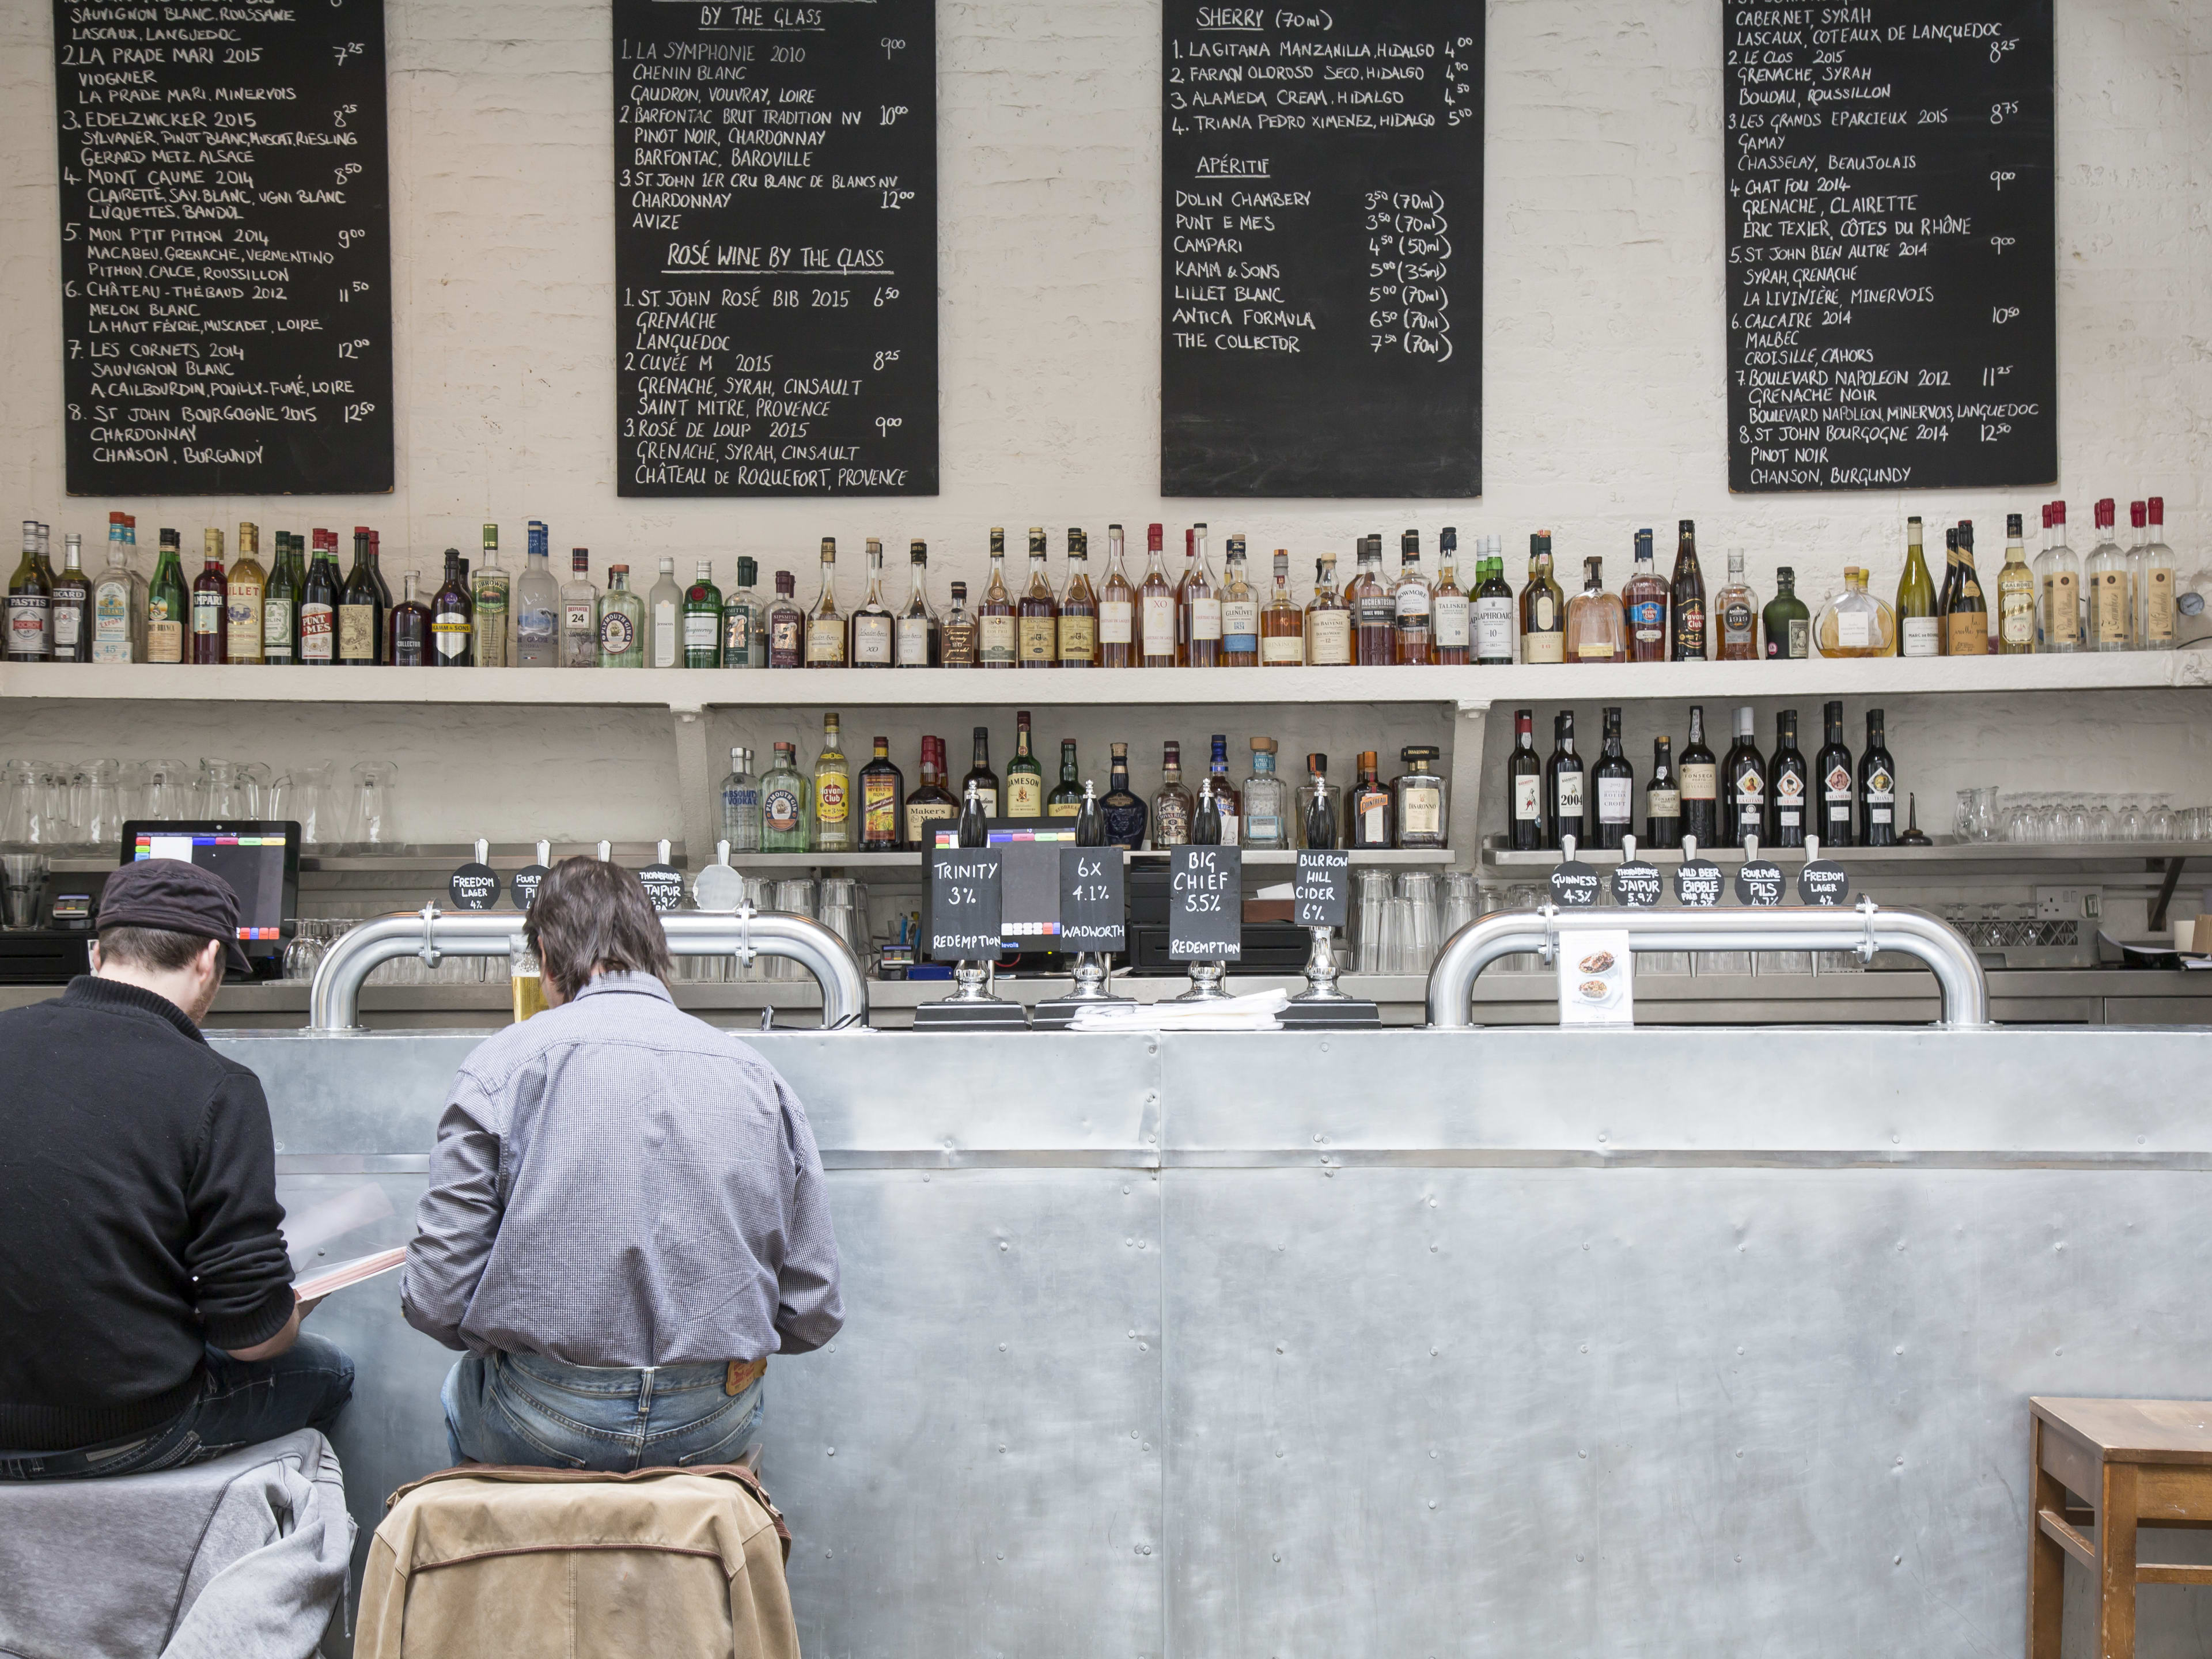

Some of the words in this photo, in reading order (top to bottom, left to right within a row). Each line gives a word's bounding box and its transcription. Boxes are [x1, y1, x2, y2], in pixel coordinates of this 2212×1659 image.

[702, 6, 721, 25] BY
[732, 6, 763, 25] THE
[775, 8, 821, 27] GLASS
[1196, 7, 1263, 27] SHERRY
[1276, 9, 1332, 30] (70ml)
[79, 47, 105, 65] LA
[113, 48, 165, 64] PRADE
[173, 48, 213, 63] MARI
[224, 48, 263, 63] 2015
[637, 42, 656, 59] LA
[664, 42, 755, 61] SYMPHONIE
[771, 46, 805, 62] 2010
[79, 70, 157, 86] VIOGNIER
[86, 112, 207, 127] EDELZWICKER
[214, 112, 256, 127] 2015
[635, 107, 712, 123] BARFONTAC
[724, 108, 756, 124] BRUT
[763, 110, 831, 124] TRADITION
[842, 112, 861, 124] NV
[1738, 133, 1785, 154] GAMAY
[1198, 154, 1268, 173] APÉRITIF
[89, 169, 136, 184] MONT
[148, 171, 204, 185] CAUME
[216, 171, 253, 188] 2014
[1745, 179, 1780, 195] CHAT
[1785, 179, 1808, 194] FOU
[1817, 176, 1850, 191] 2014
[632, 191, 731, 208] CHARDONNAY
[1176, 191, 1222, 207] DOLIN
[1232, 191, 1310, 207] CHAMBERY
[1176, 214, 1213, 230] PUNT
[1224, 216, 1233, 228] E
[1240, 215, 1274, 231] MES
[1174, 236, 1241, 253] CAMPARI
[668, 240, 710, 265] ROSÉ
[718, 246, 761, 267] WINE
[770, 247, 790, 267] BY
[801, 248, 830, 267] THE
[837, 248, 884, 275] GLASS
[1176, 260, 1221, 278] KAMM
[1228, 266, 1238, 278] &
[1241, 262, 1279, 279] SONS
[1176, 286, 1226, 301] LILLET
[1234, 287, 1285, 302] BLANC
[90, 304, 139, 316] MELON
[149, 304, 200, 316] BLANC
[637, 312, 717, 334] GRENACHE
[1745, 313, 1812, 328] CALCAIRE
[1822, 310, 1851, 325] 2014
[637, 332, 729, 353] LANGUEDOC
[1173, 333, 1207, 347] THE
[1215, 335, 1300, 353] COLLECTOR
[1746, 331, 1799, 349] MALBEC
[91, 342, 119, 357] LES
[130, 343, 200, 358] CORNETS
[210, 343, 244, 360] 2014
[1749, 369, 1828, 386] BOULEVARD
[1836, 370, 1908, 386] NAPOLEON
[1918, 370, 1950, 386] 2012
[1749, 388, 1833, 408] GRENACHE
[1840, 388, 1877, 402] NOIR
[93, 406, 118, 422] ST
[128, 408, 169, 422] JOHN
[182, 406, 278, 422] BOURGOGNE
[281, 406, 317, 422] 2015
[90, 424, 196, 442] CHARDONNAY
[1751, 446, 1789, 465] PINOT
[1796, 447, 1828, 463] NOIR
[10, 598, 47, 607] PASTIS
[1397, 590, 1427, 600] BOWMORE
[1152, 600, 1168, 608] XO
[302, 614, 326, 627] PUNT
[571, 614, 584, 623] 24
[1477, 612, 1512, 620] LAPHROAIG
[1688, 620, 1702, 628] Club
[306, 622, 331, 634] MES
[601, 614, 626, 635] PLYMOUTH
[1490, 629, 1497, 637] 10
[1008, 778, 1039, 788] JAMESON
[766, 791, 793, 811] PLYMOUTH
[1362, 797, 1386, 811] COINTREAU
[1561, 794, 1583, 805] 2004
[1078, 857, 1101, 877] 6X
[1189, 852, 1215, 873] BIG
[1300, 854, 1347, 866] BURROW
[934, 862, 997, 879] TRINITY
[1306, 871, 1331, 883] HILL
[1616, 868, 1659, 877] THORNBRIDGE
[1677, 868, 1698, 878] WILD
[1699, 868, 1721, 877] BEER
[1804, 870, 1844, 882] FREEDOM
[453, 876, 494, 887] FREEDOM
[1174, 872, 1228, 890] CHIEF
[1552, 873, 1597, 888] GUINNESS
[1618, 880, 1660, 892] JAIPUR
[1683, 880, 1719, 893] BIBBLE
[1810, 884, 1837, 892] LAGER
[461, 888, 487, 897] LAGER
[949, 887, 976, 904] 3%
[1073, 885, 1109, 900] 4.1%
[1296, 887, 1335, 900] CIDER
[1564, 889, 1592, 903] 4.3%
[1681, 892, 1699, 901] PALE
[1701, 892, 1715, 901] ALE
[1751, 882, 1777, 896] PILS
[471, 900, 482, 909] 4%
[1185, 894, 1221, 911] 5.5%
[1628, 893, 1652, 902] 5.9%
[1817, 895, 1835, 907] 4%
[1303, 903, 1324, 920] 6%
[1062, 925, 1124, 938] WADWORTH
[934, 935, 1001, 949] REDEMPTION
[1172, 940, 1240, 954] REDEMPTION
